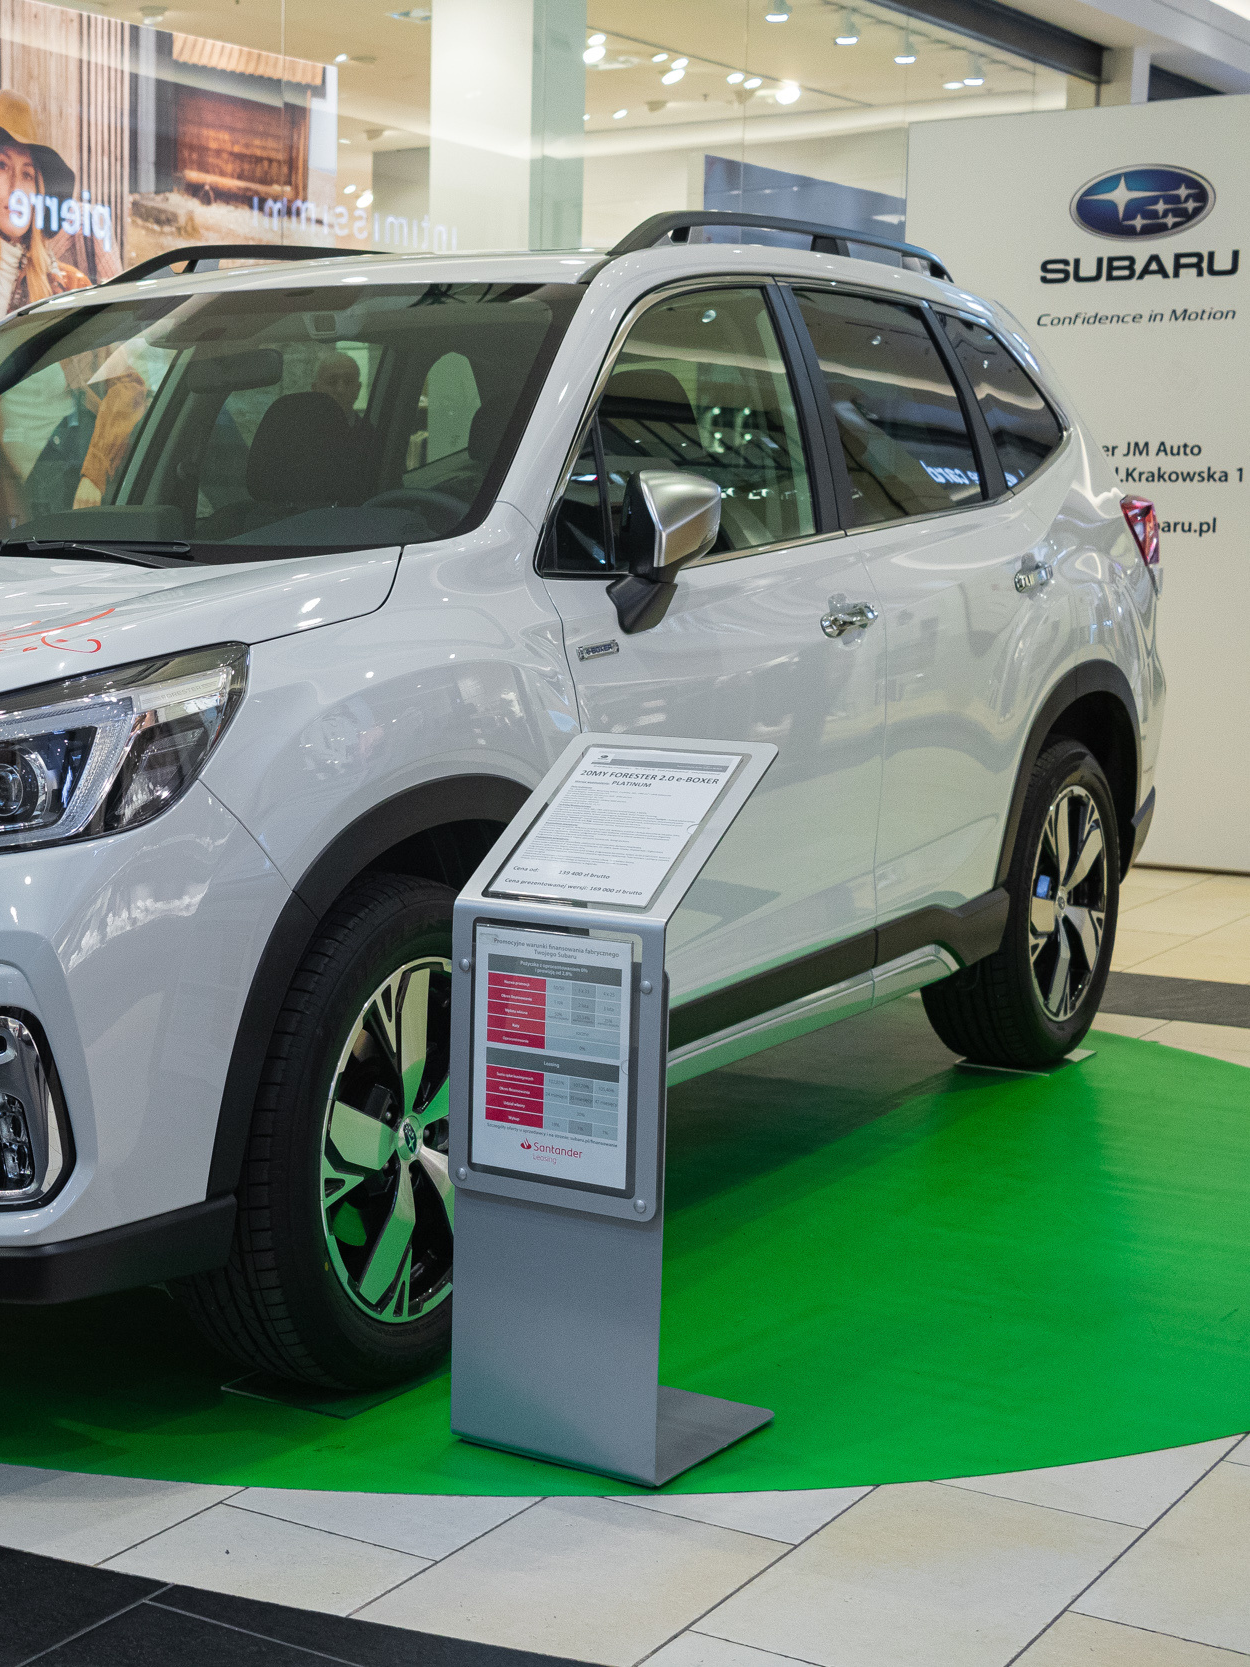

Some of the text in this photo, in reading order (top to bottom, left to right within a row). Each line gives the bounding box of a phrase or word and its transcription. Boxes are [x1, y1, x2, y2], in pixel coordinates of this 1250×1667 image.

[1040, 250, 1240, 284] SUBARU
[1037, 308, 1237, 327] Confidence in Motion
[1123, 441, 1150, 457] JM
[1155, 441, 1202, 457] Auto
[1236, 467, 1244, 483] 1
[608, 771, 658, 780] FORESTER
[675, 776, 720, 784] e-BOXER
[519, 879, 567, 889] prezentowanej
[493, 937, 619, 959] Promocyjne warunki finansowania fabrycznego
[534, 949, 556, 957] Twojego
[543, 1060, 559, 1068] Leasing
[533, 1141, 582, 1159] Santander
[532, 1153, 556, 1164] Leasing
